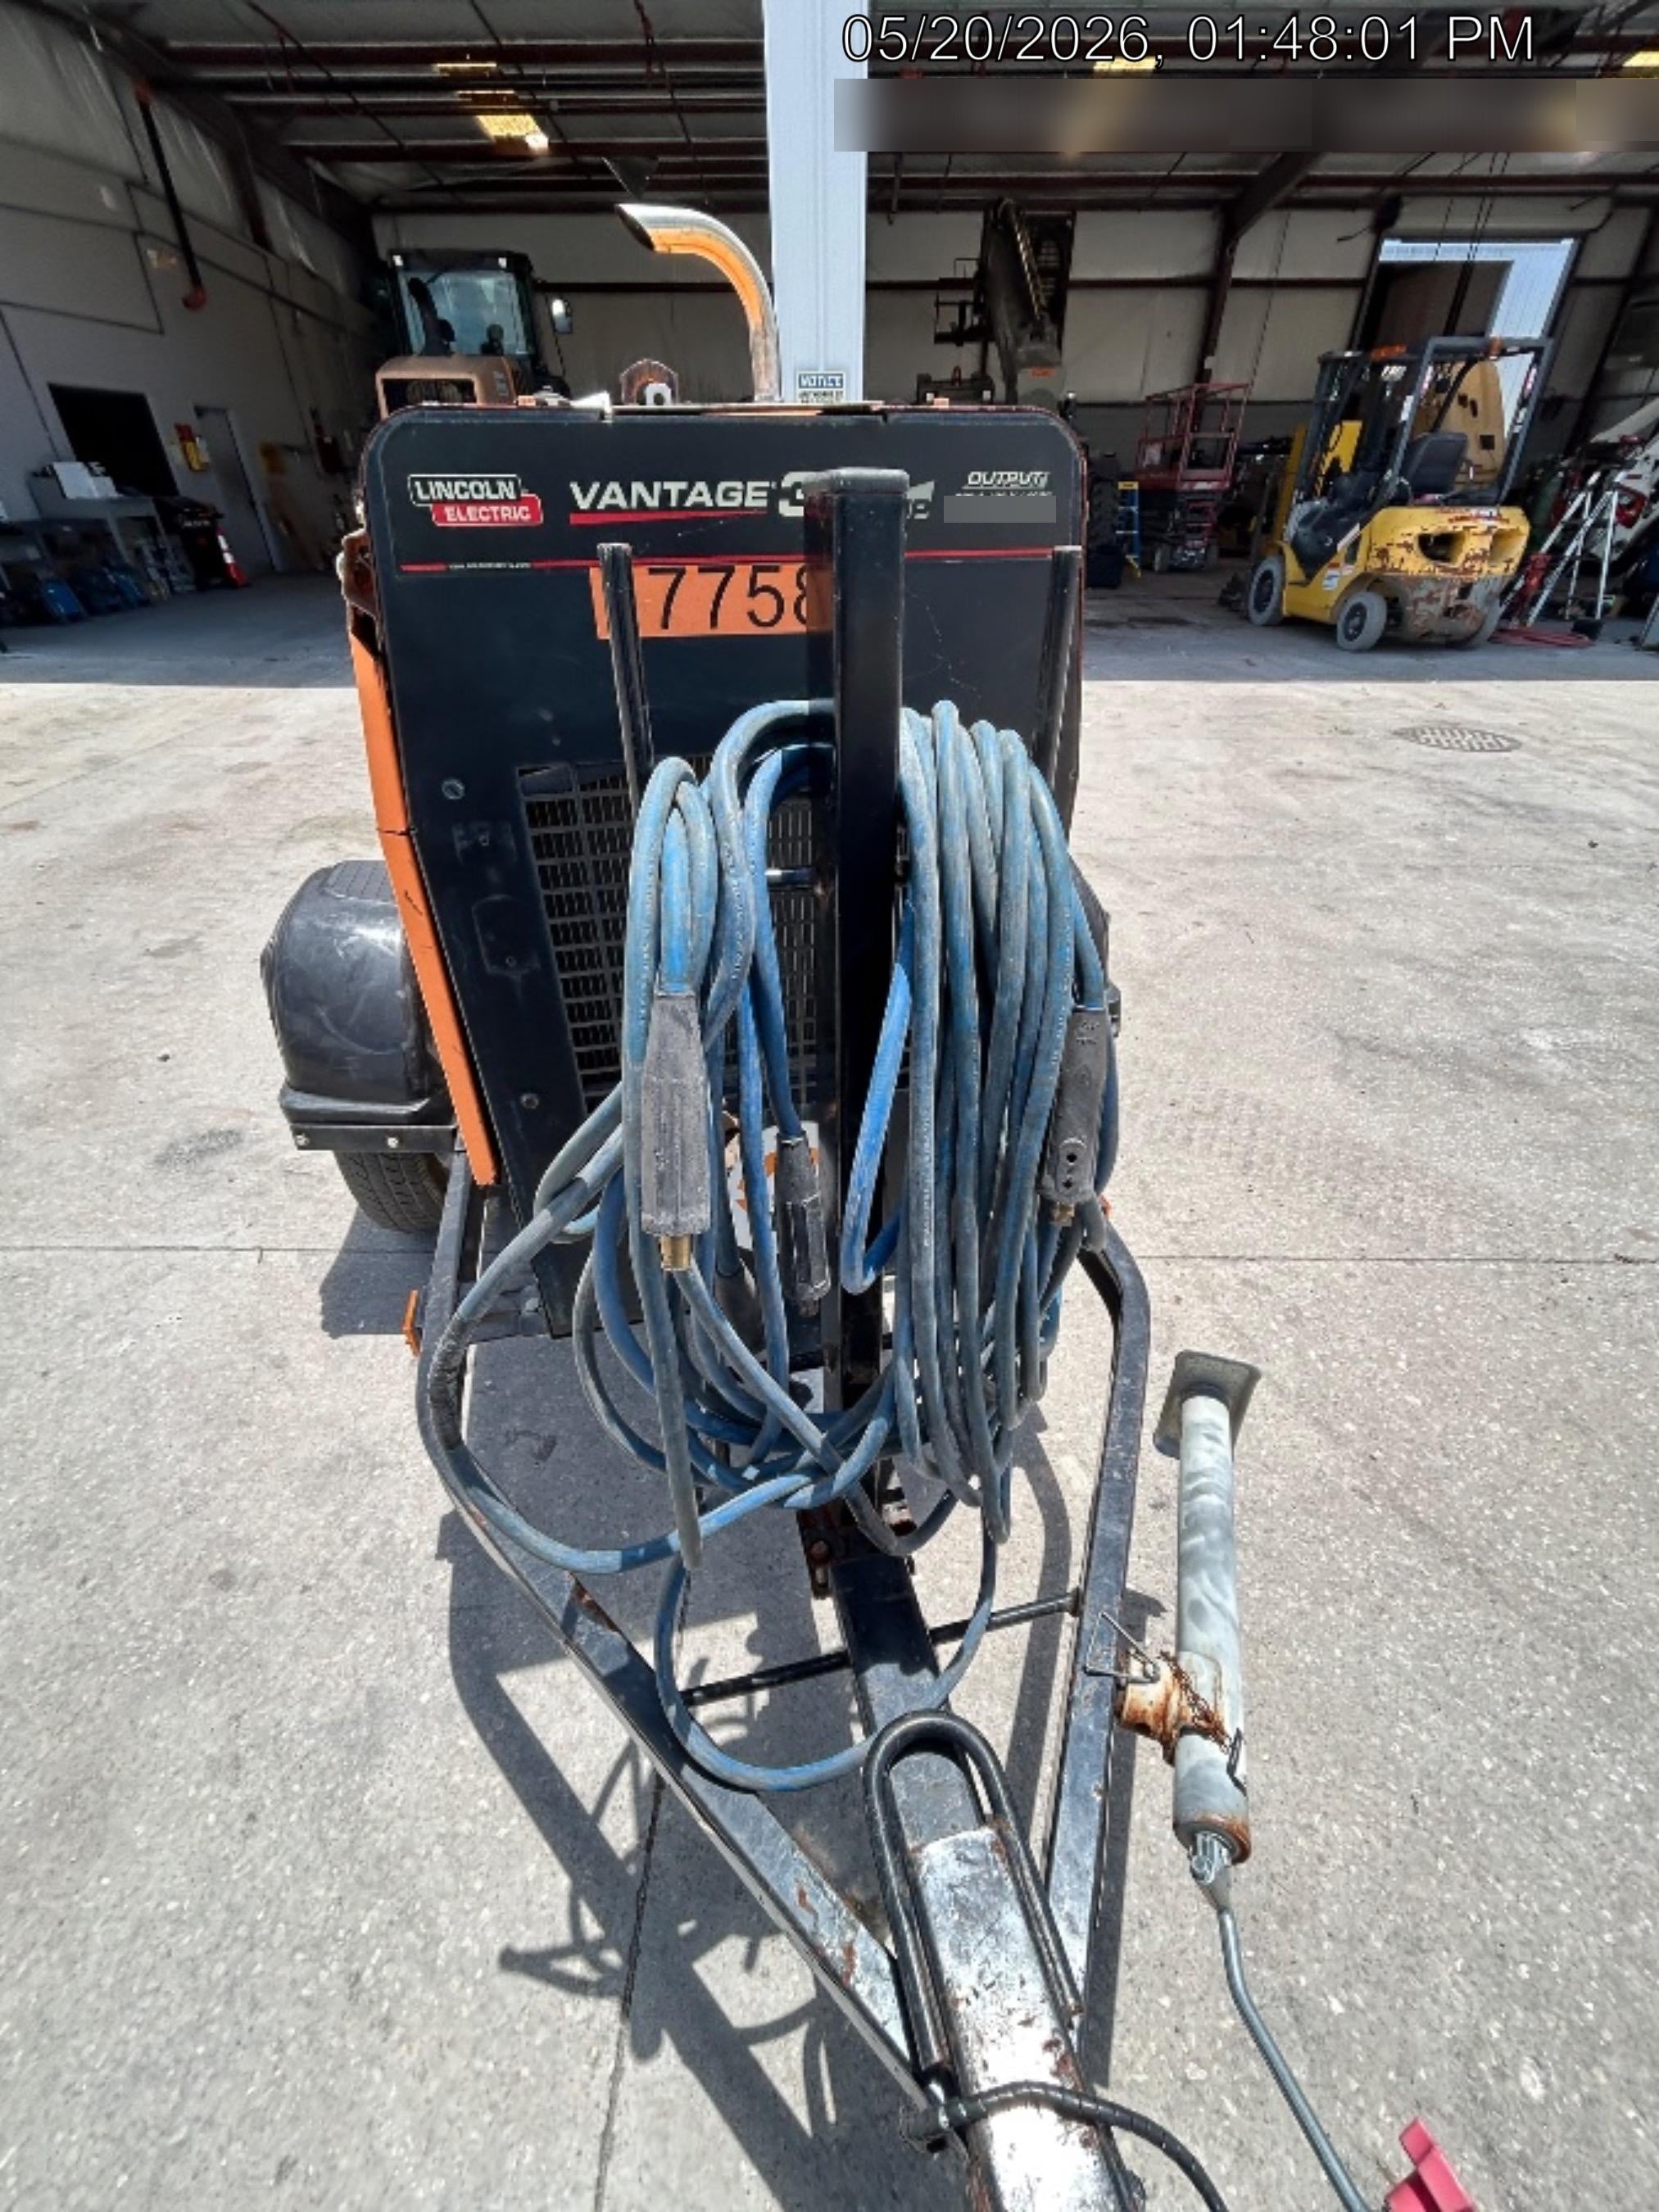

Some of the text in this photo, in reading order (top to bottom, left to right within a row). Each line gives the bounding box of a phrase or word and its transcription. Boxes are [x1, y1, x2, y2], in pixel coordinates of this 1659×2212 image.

[967, 470, 1049, 485] OUTPUT
[414, 480, 517, 501] LINCOLN
[569, 480, 770, 510] VANTAGE
[443, 505, 532, 523] ELECTRIC
